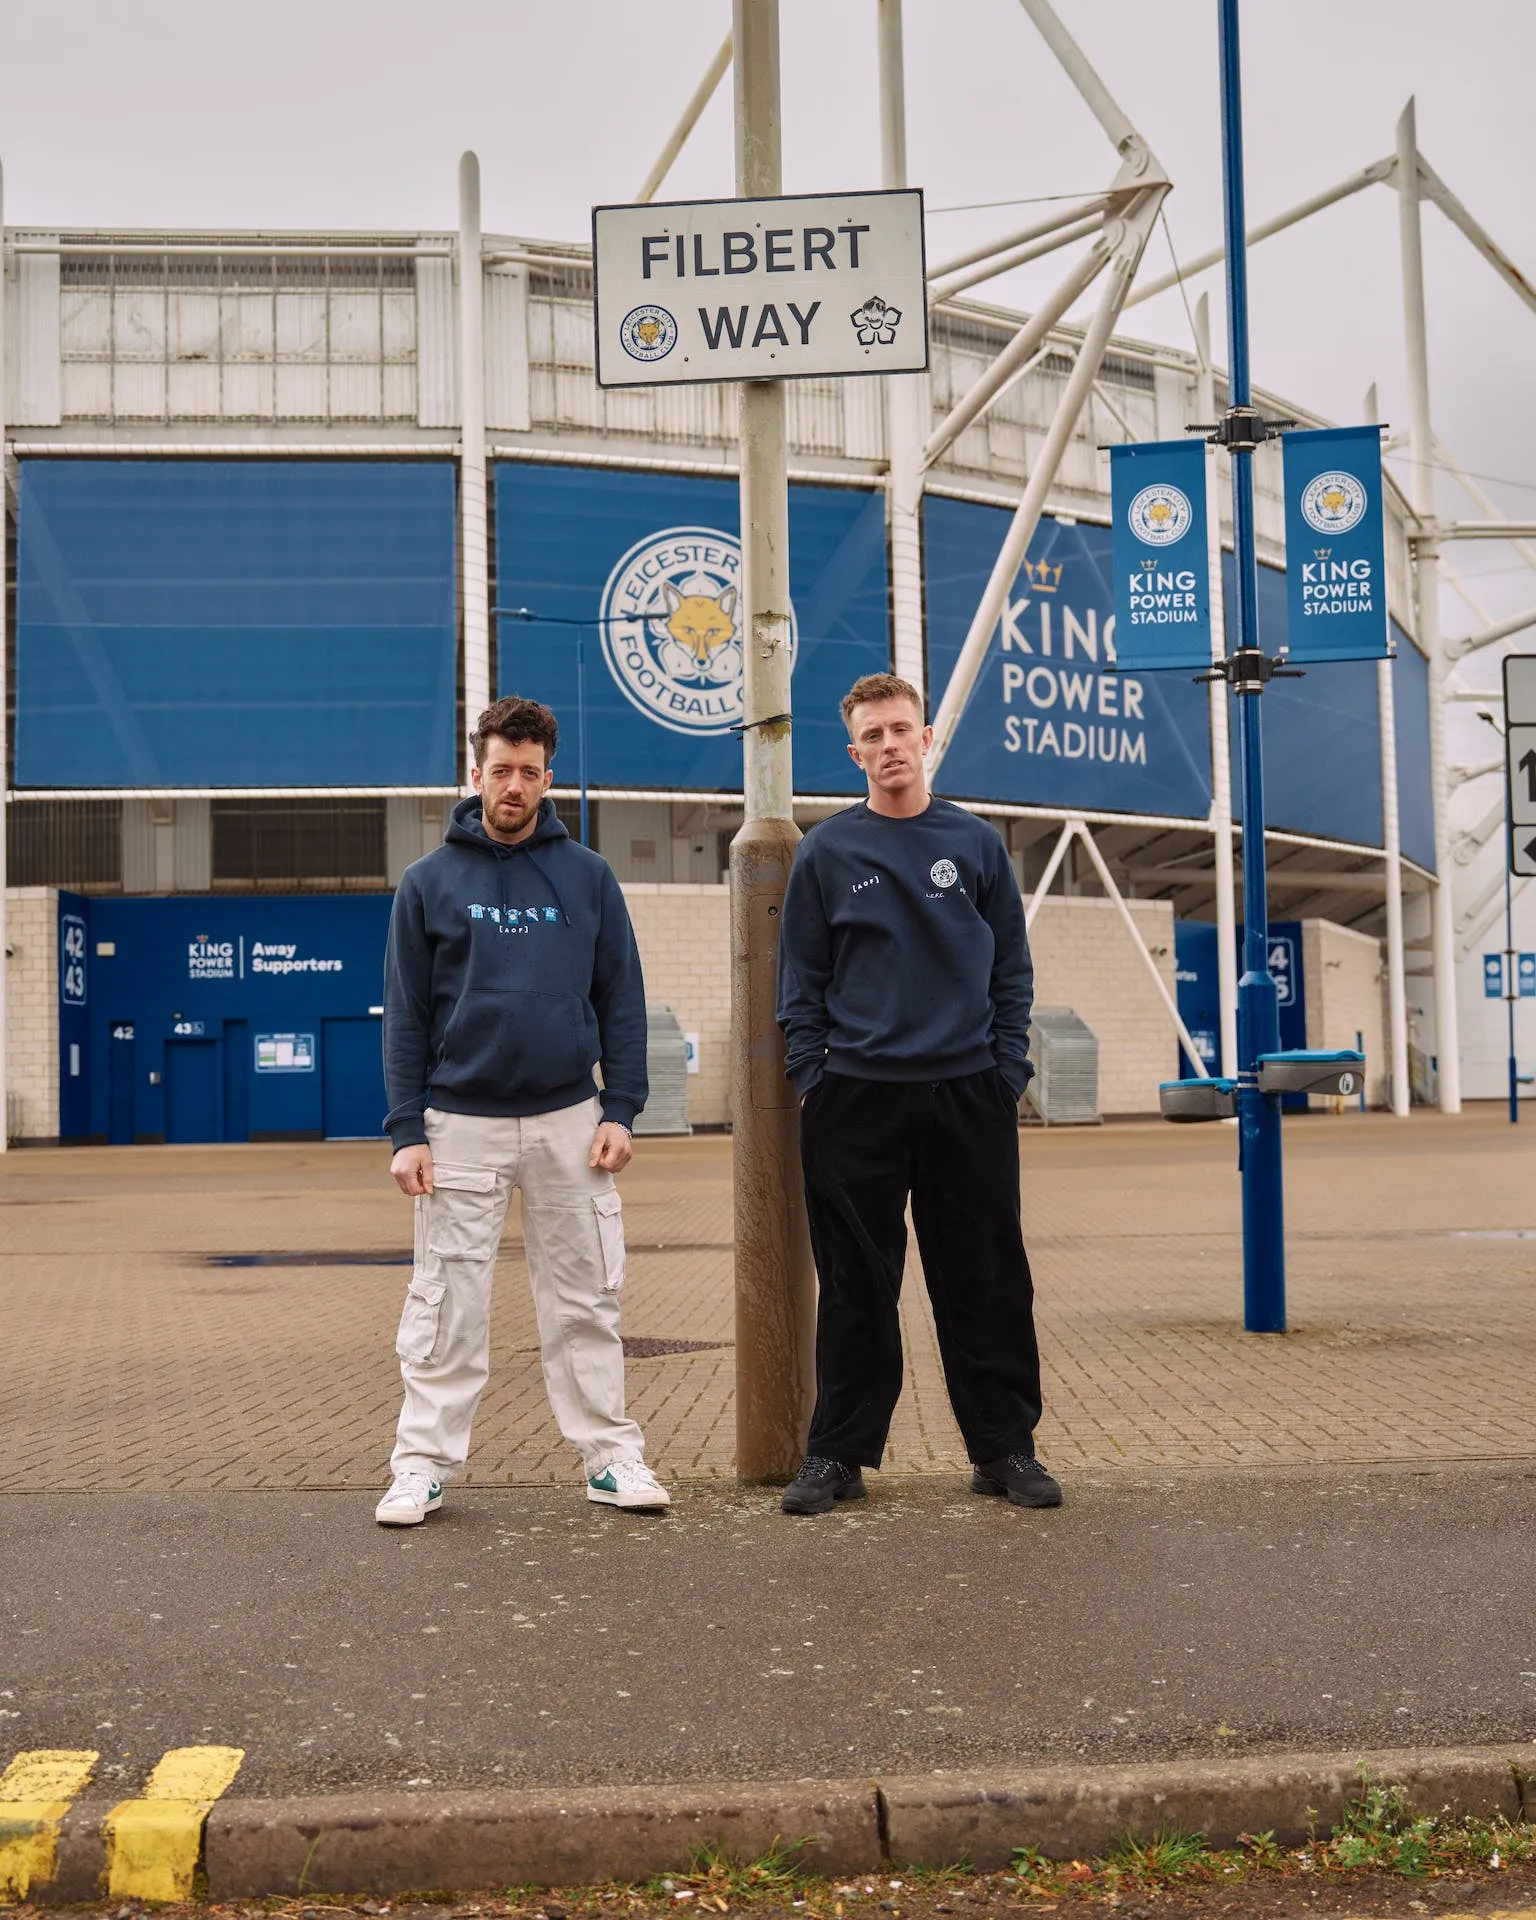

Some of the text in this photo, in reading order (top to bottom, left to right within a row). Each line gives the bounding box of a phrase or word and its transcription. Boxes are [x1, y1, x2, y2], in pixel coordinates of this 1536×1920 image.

[642, 224, 870, 279] FILBERT
[624, 308, 674, 331] LEICESTER CITY
[698, 301, 822, 350] WAY
[624, 335, 674, 359] FOOTBALL CLUB
[619, 545, 741, 617] LEICESTER
[1129, 570, 1197, 594] KING
[1302, 559, 1372, 584] KING
[1130, 592, 1196, 610] POWER
[1303, 581, 1371, 601] POWER
[1131, 609, 1198, 625] STADIUM
[1303, 599, 1373, 616] STADIUM
[619, 634, 736, 717] FOOTBALL
[1002, 662, 1145, 720] POWER
[1003, 714, 1148, 767] STADIUM
[65, 926, 84, 958] 42
[188, 942, 233, 957] KING
[252, 941, 297, 959] Away
[188, 957, 233, 969] POWER
[252, 957, 343, 975] Supporters
[1268, 945, 1289, 970] 4
[65, 964, 84, 997] 43
[189, 968, 234, 979] STADIUM
[113, 1026, 135, 1040] 42
[173, 1022, 192, 1035] 43
